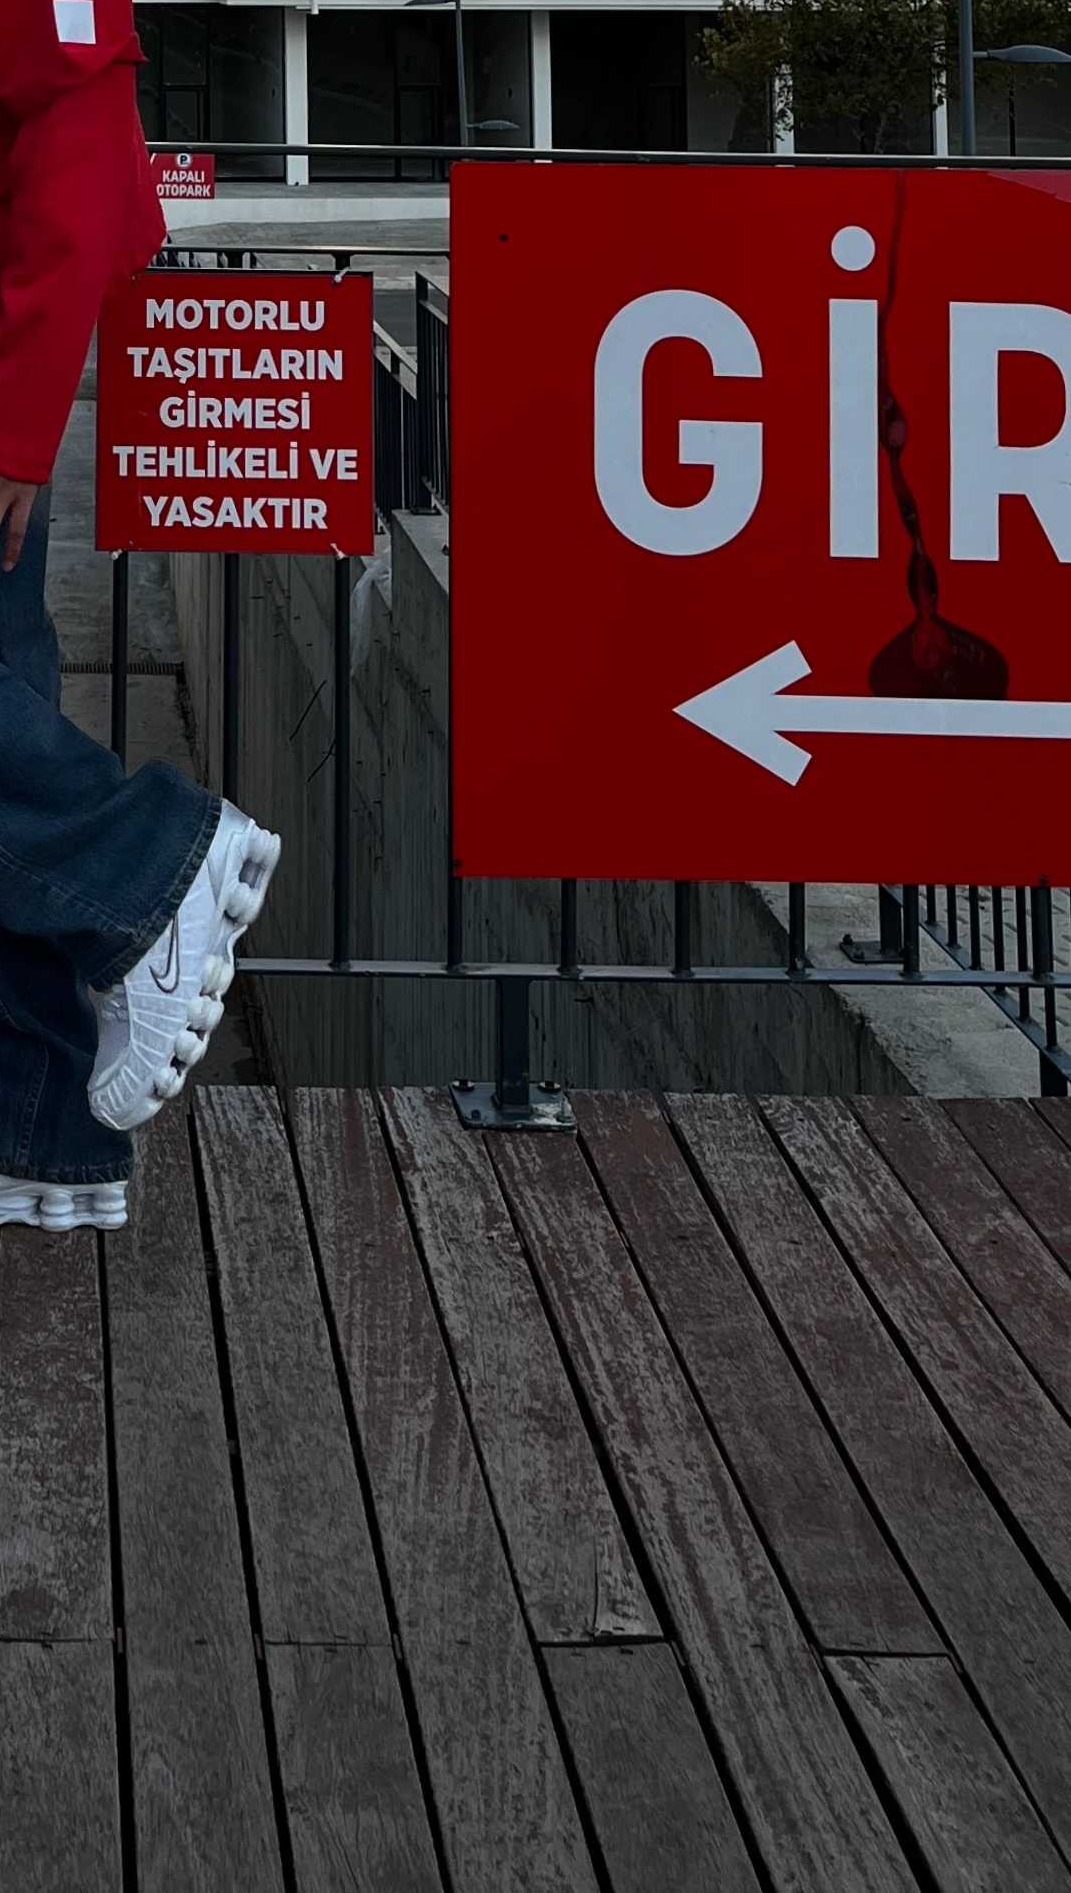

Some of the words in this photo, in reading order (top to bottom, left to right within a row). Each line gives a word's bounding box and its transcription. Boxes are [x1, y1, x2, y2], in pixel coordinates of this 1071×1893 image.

[156, 184, 211, 197] OTOPARK
[162, 170, 205, 183] KAPALI
[146, 298, 325, 331] MOTORLU
[126, 346, 343, 385] TAŞITLARIN
[159, 390, 310, 430] GİRMESİ
[112, 439, 299, 480] TEHLİKELİ
[309, 448, 358, 480] VE
[142, 495, 328, 530] YASAKTIR
